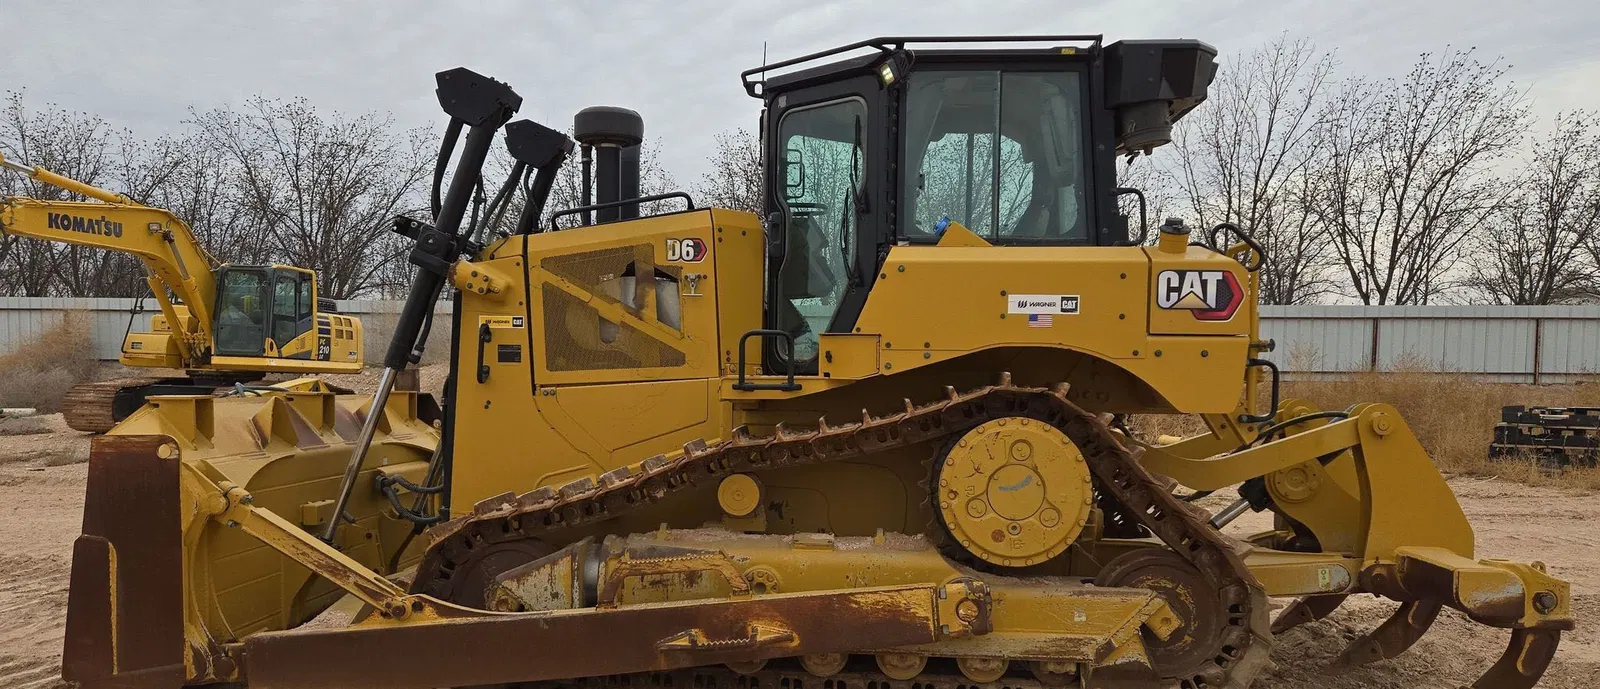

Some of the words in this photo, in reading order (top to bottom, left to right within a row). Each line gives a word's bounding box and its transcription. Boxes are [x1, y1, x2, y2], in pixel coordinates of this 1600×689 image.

[48, 212, 123, 238] KOMATSU
[666, 239, 694, 261] D6
[1157, 270, 1223, 309] CAT
[1062, 300, 1077, 309] CAT
[319, 346, 330, 354] 210
